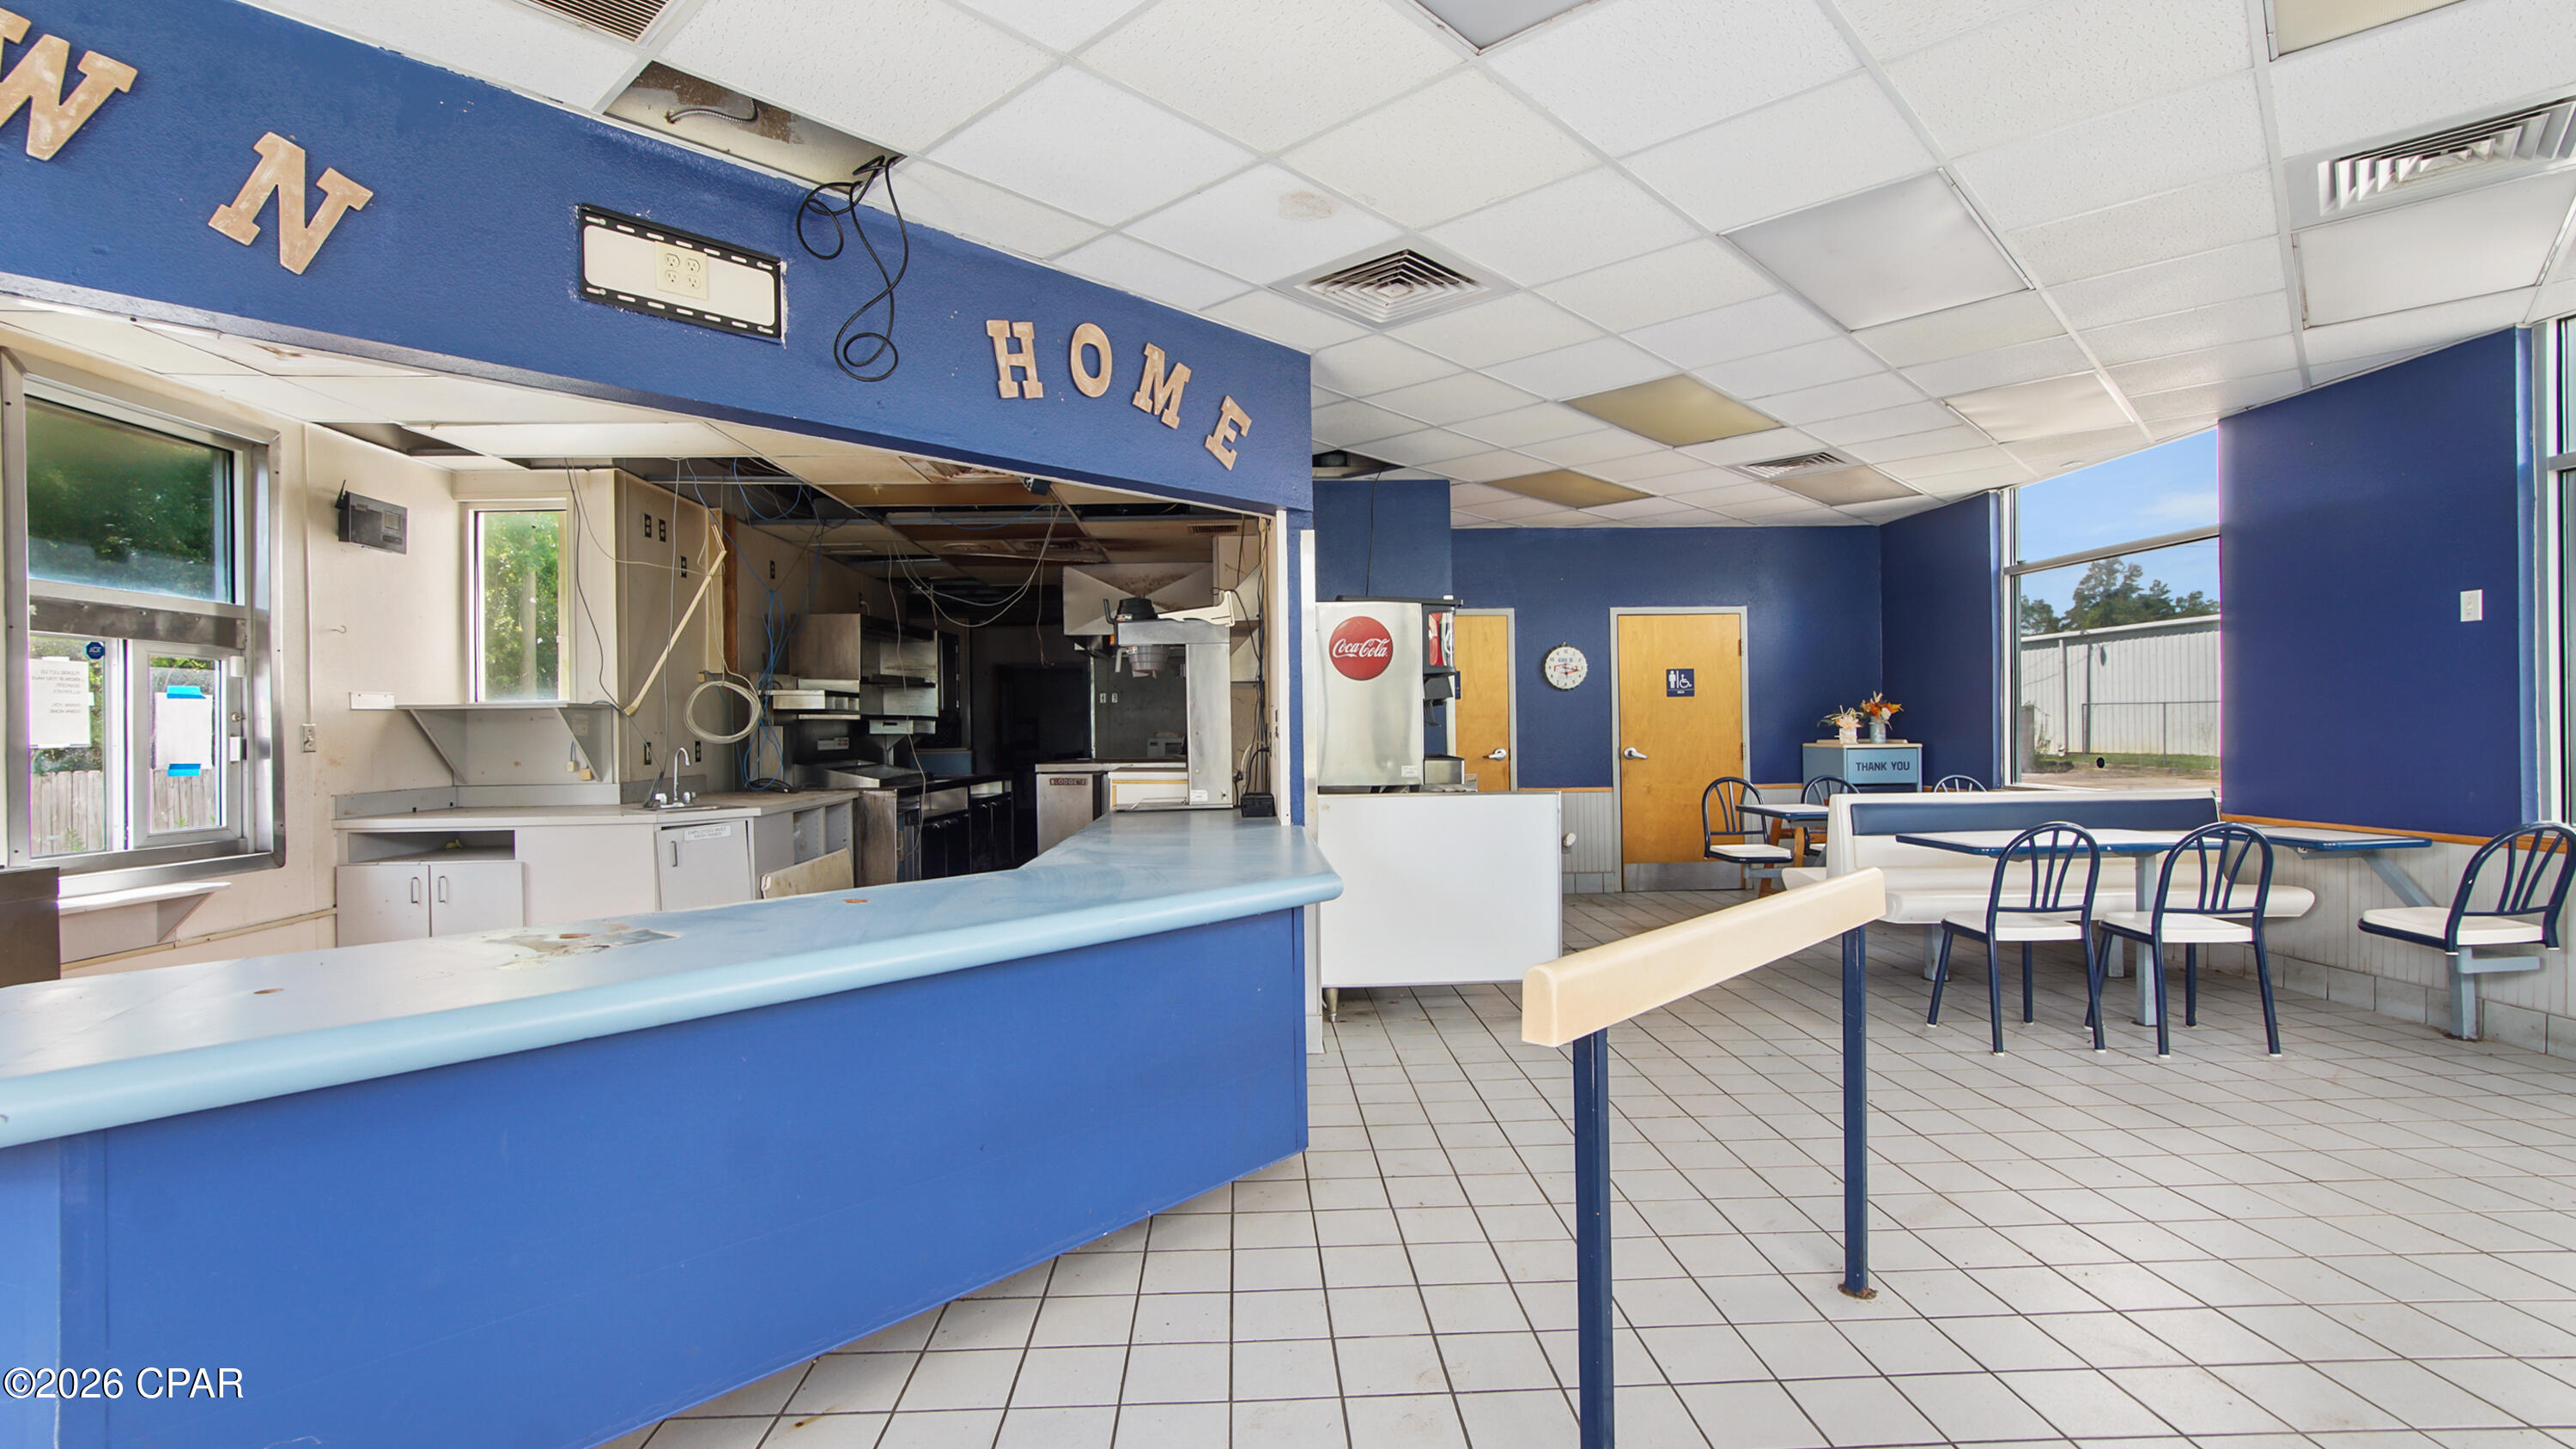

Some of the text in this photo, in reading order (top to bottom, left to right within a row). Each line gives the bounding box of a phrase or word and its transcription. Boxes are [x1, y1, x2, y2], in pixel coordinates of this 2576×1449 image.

[986, 319, 1253, 471] HOME
[1332, 638, 1391, 658] Coca-Cola
[1856, 761, 1911, 772] THANK YOU
